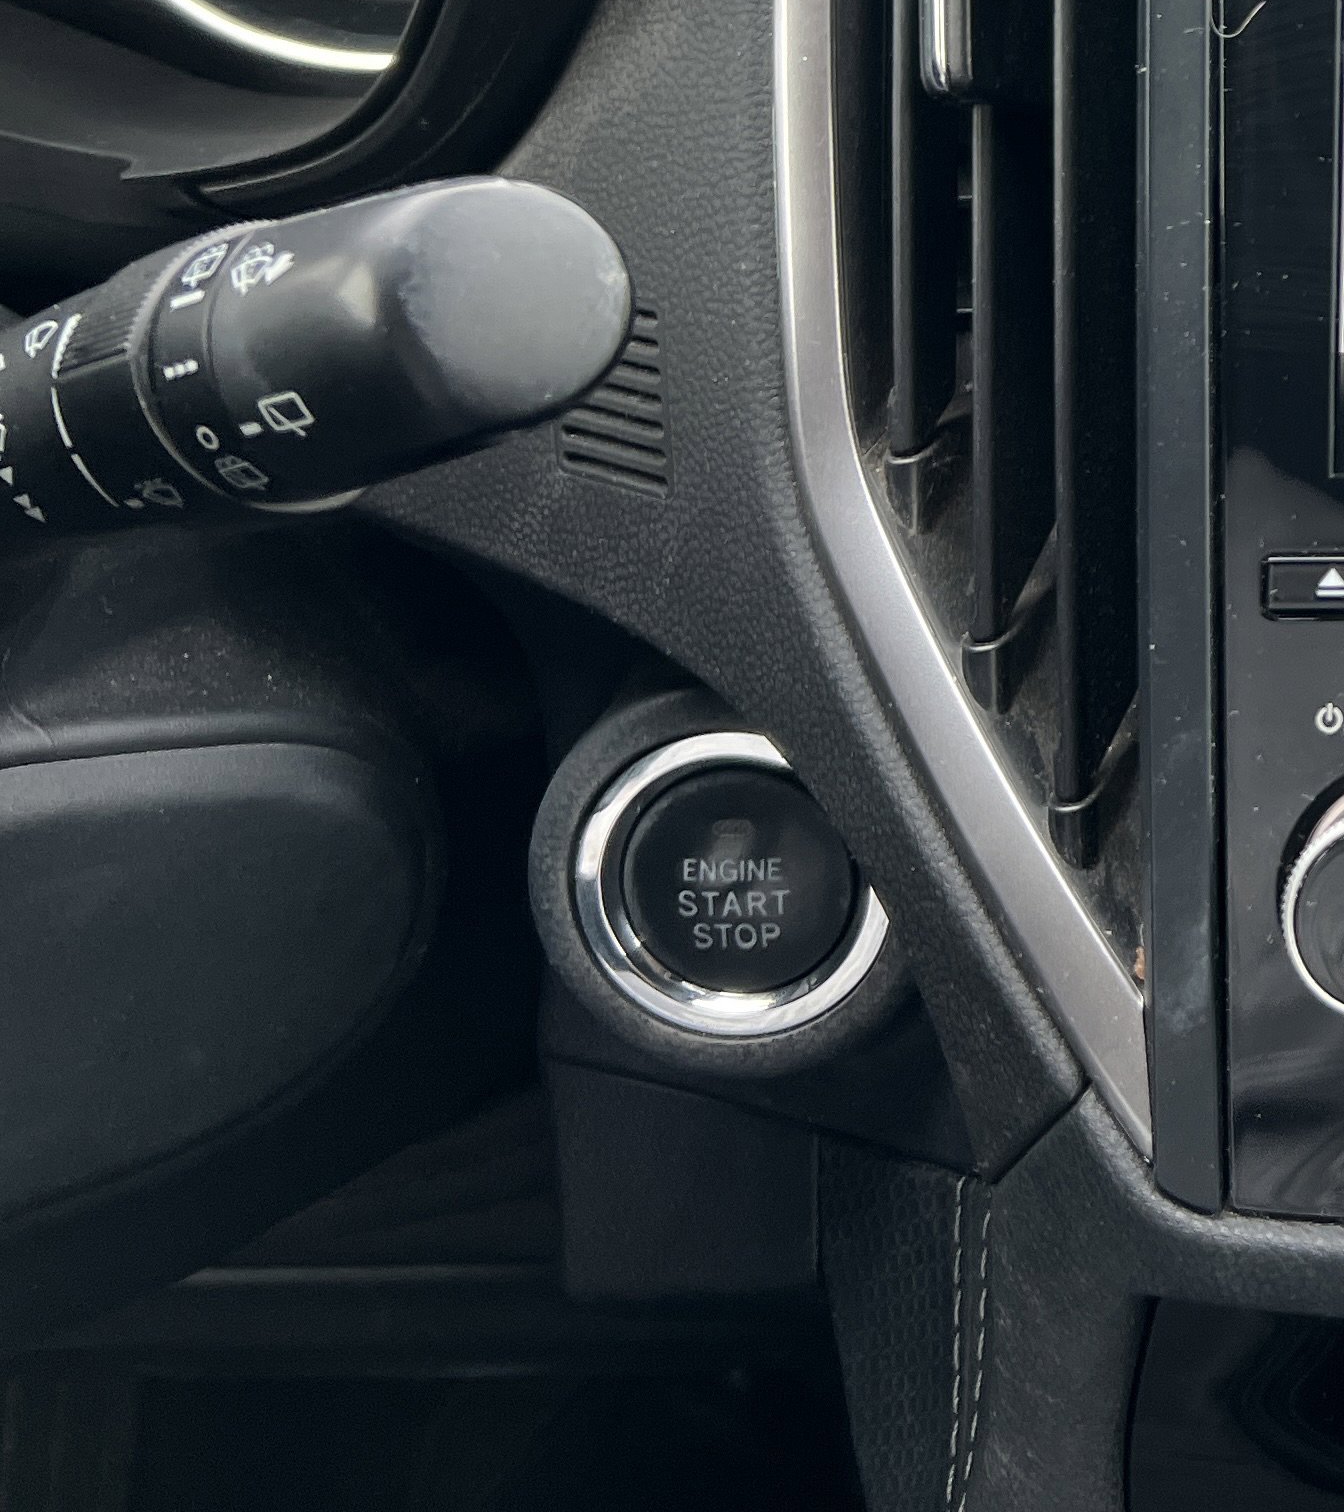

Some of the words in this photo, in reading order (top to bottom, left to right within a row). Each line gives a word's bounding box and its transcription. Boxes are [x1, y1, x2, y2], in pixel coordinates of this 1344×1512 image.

[682, 857, 783, 882] ENGINE
[677, 889, 791, 919] START
[692, 922, 782, 951] STOP
